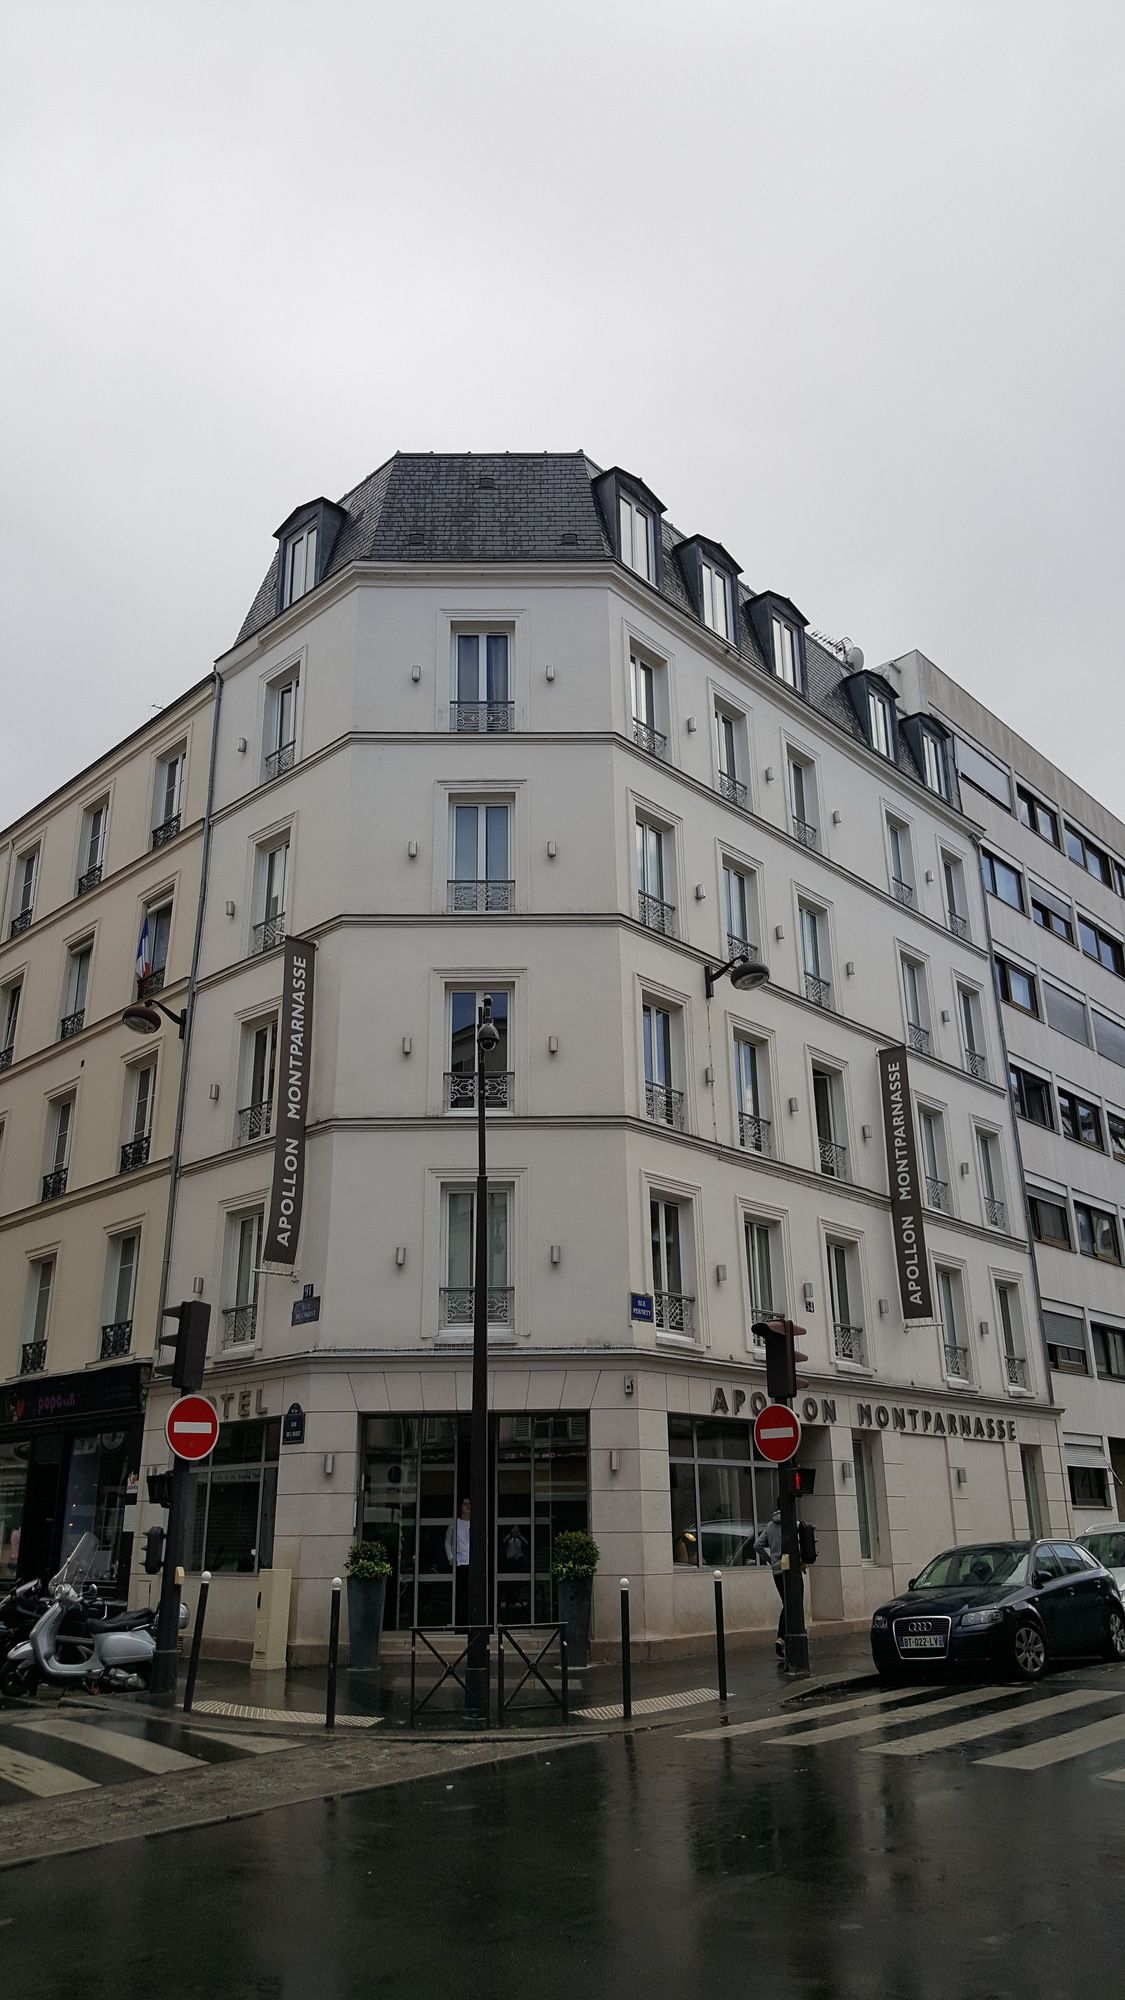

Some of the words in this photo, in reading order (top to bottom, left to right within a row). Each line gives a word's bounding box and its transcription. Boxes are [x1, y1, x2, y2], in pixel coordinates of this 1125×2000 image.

[287, 955, 307, 1120] MONTPARNASSE
[887, 1061, 912, 1200] MONTPARNASSE
[276, 1137, 299, 1248] APOLLON
[901, 1215, 923, 1305] APOLLON
[711, 1387, 837, 1424] APOLON
[857, 1403, 1017, 1441] MONTPARNASSE
[904, 1636, 938, 1647] BT-022-LV
